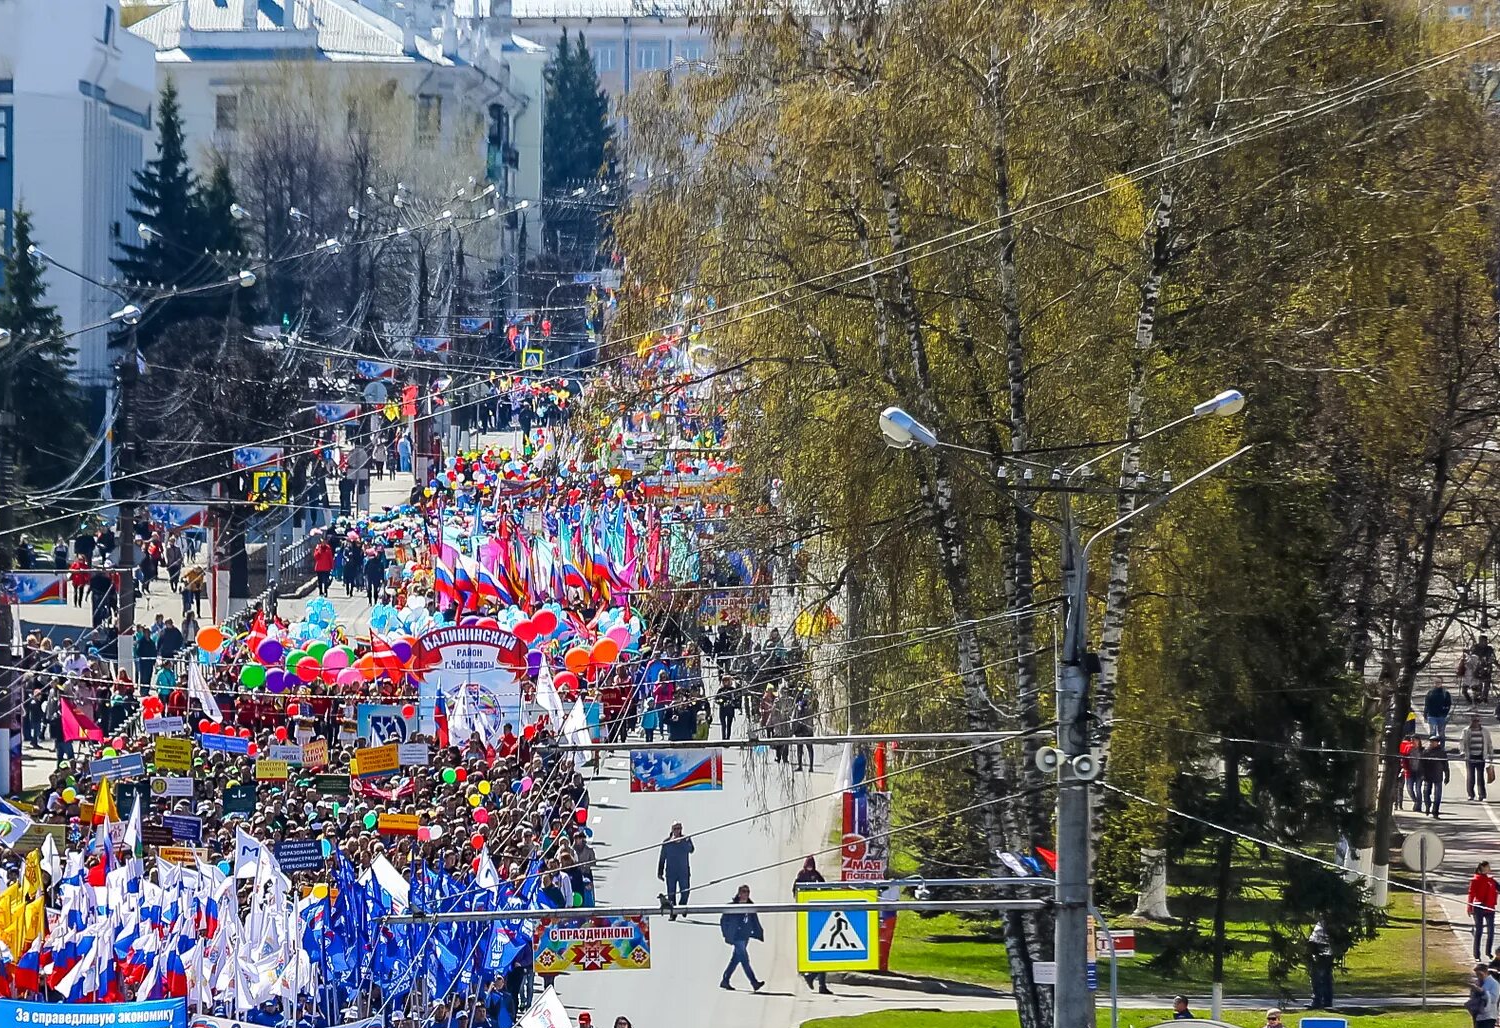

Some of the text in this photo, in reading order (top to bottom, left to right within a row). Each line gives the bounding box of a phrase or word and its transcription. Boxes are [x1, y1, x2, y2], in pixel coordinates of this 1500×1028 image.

[422, 628, 518, 652] КАЛИНИНСКИЙ
[456, 648, 483, 657] РАЙОН
[852, 860, 882, 870] МАЯ
[551, 931, 558, 940] С
[15, 1008, 174, 1026] За справедливую экономику
